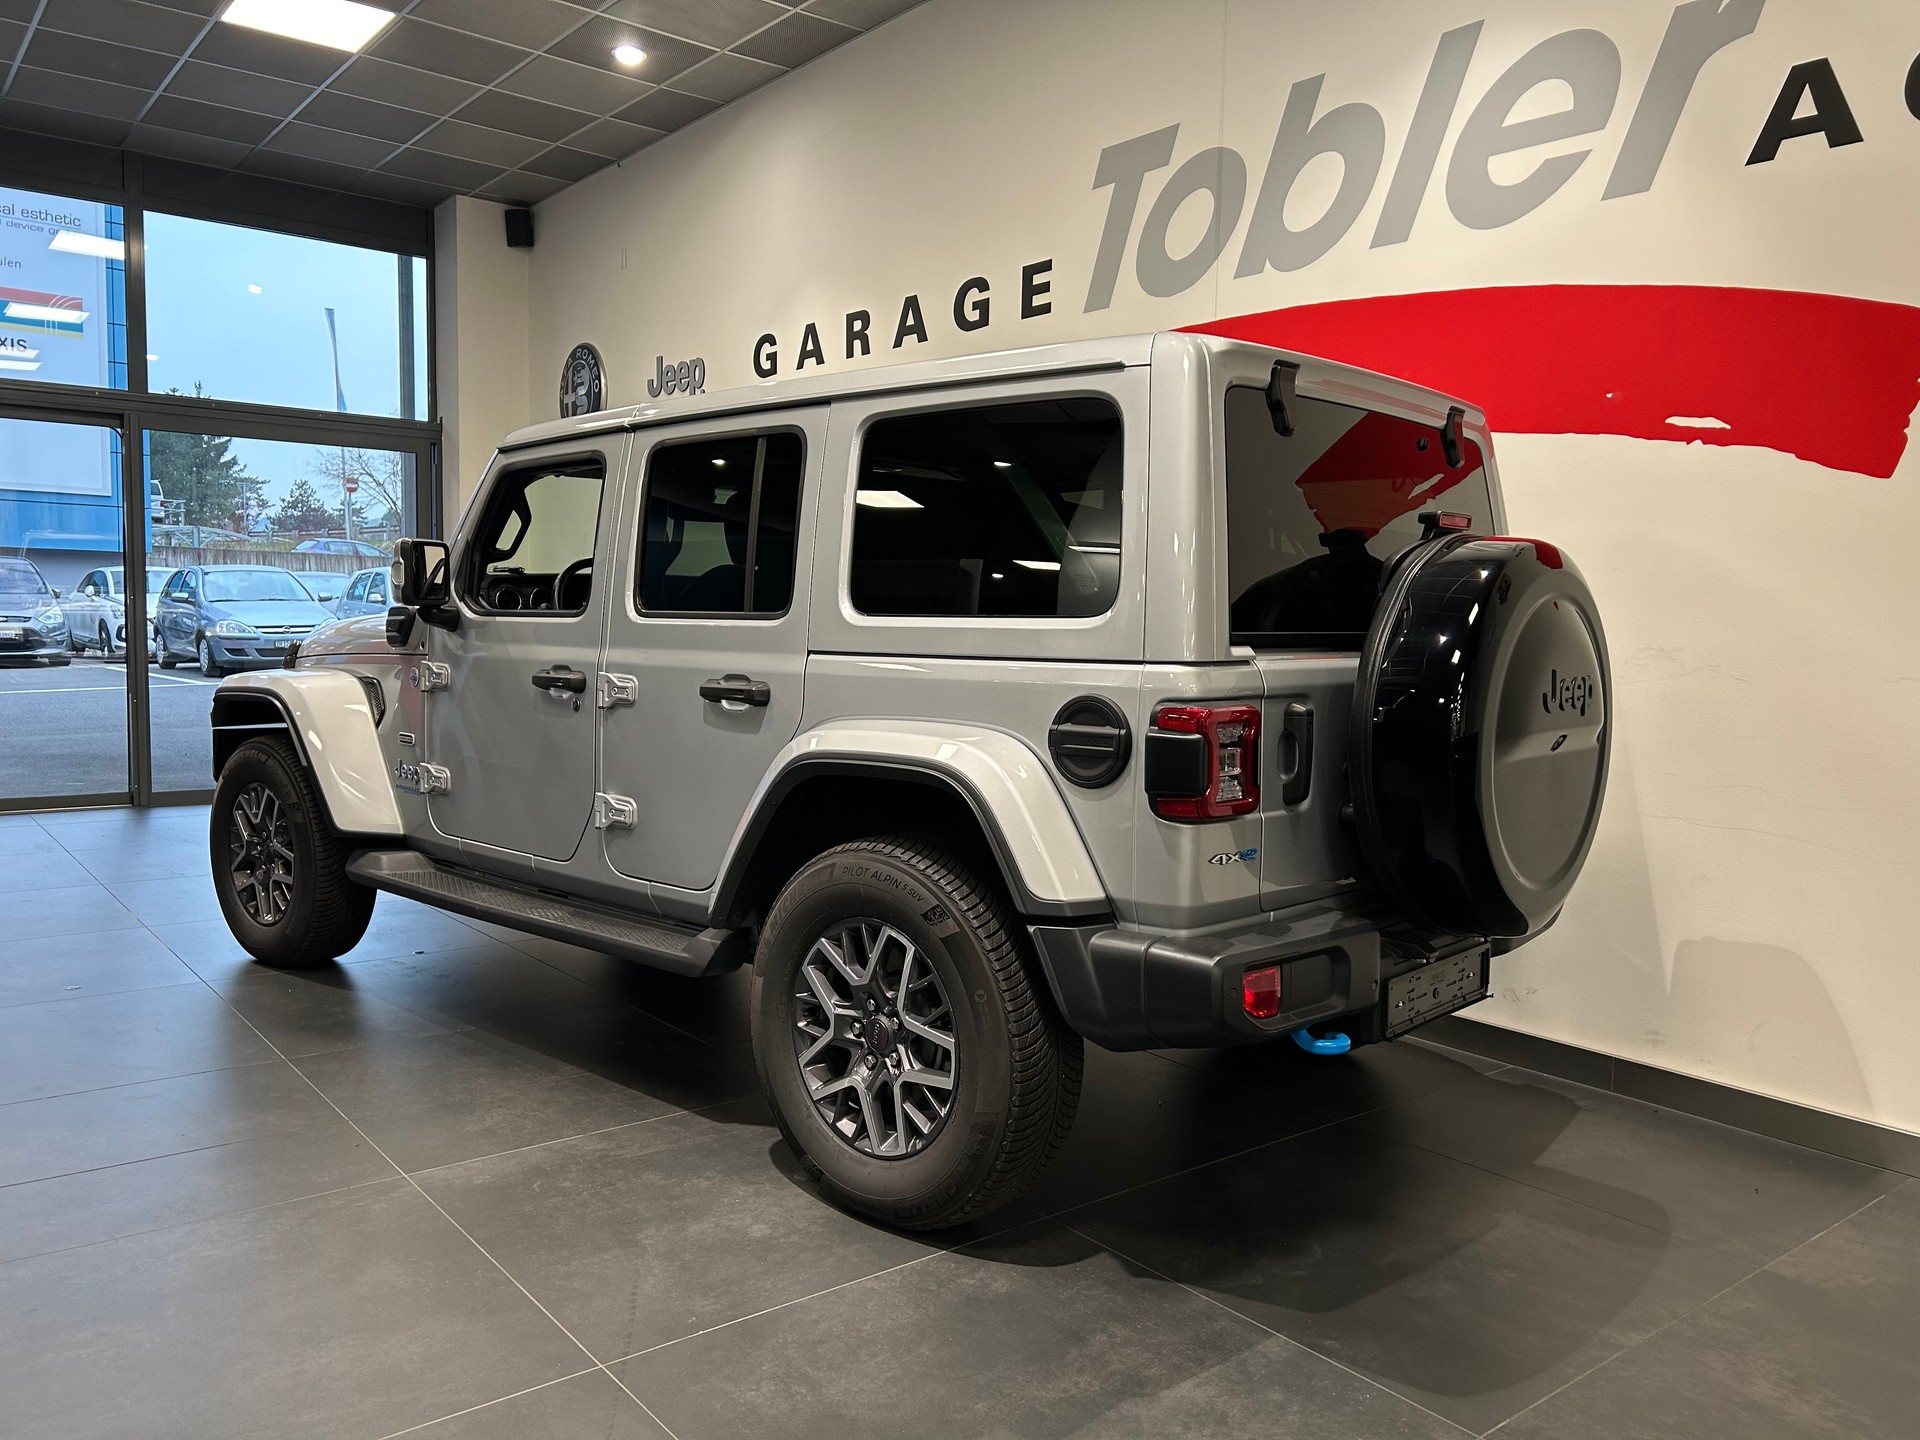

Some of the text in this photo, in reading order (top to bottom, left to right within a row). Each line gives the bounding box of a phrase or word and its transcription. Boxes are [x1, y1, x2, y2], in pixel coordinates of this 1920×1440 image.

[1744, 51, 1920, 167] A
[1083, 0, 1766, 314] Tobler
[0, 203, 15, 216] al
[21, 208, 82, 227] esthetic
[6, 220, 44, 232] device
[752, 258, 1053, 379] GARAGE
[575, 348, 600, 393] ROMEO
[646, 355, 706, 398] Jeep
[1542, 668, 1593, 717] Jeep
[394, 758, 420, 785] Jeep
[841, 866, 870, 877] PILOT
[870, 870, 902, 889] ALPIN
[907, 888, 925, 902] SUV
